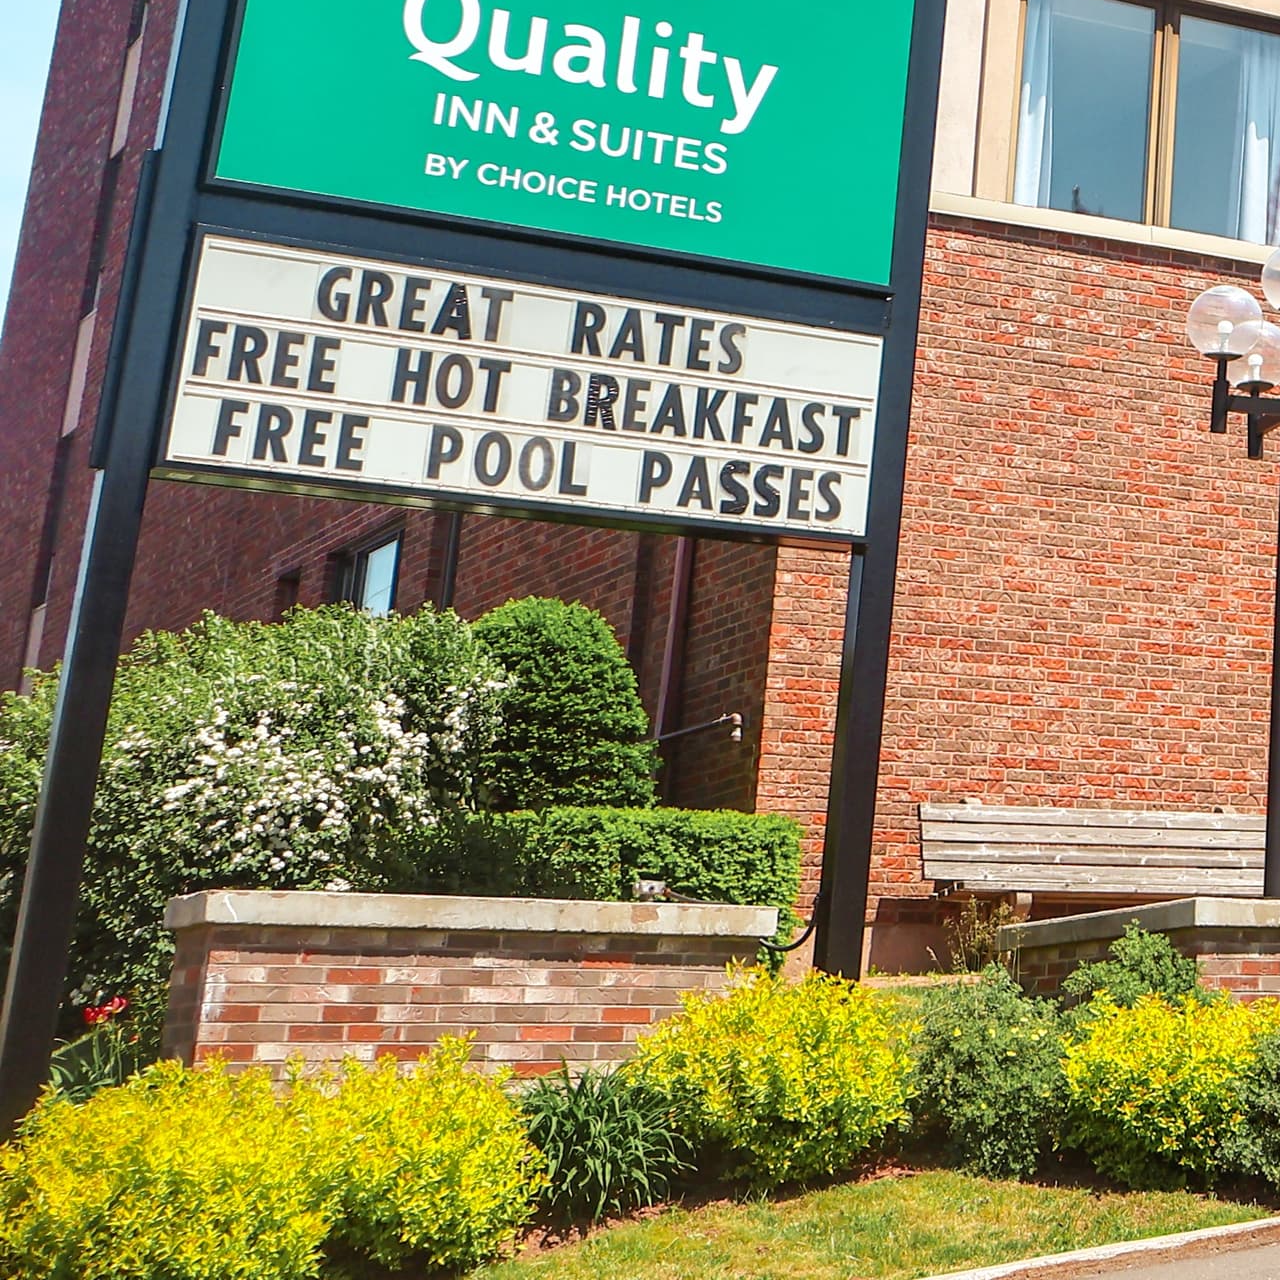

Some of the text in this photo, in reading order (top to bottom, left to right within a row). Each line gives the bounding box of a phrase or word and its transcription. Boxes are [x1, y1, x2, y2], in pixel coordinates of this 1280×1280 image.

[433, 92, 729, 175] INN & SUITES
[424, 153, 723, 224] BY CHOICE HOTELS
[318, 267, 746, 374] GREAT RATES
[193, 320, 861, 458] FREE HOT BREAKFAST
[212, 398, 842, 522] FREE POOL PASSES
